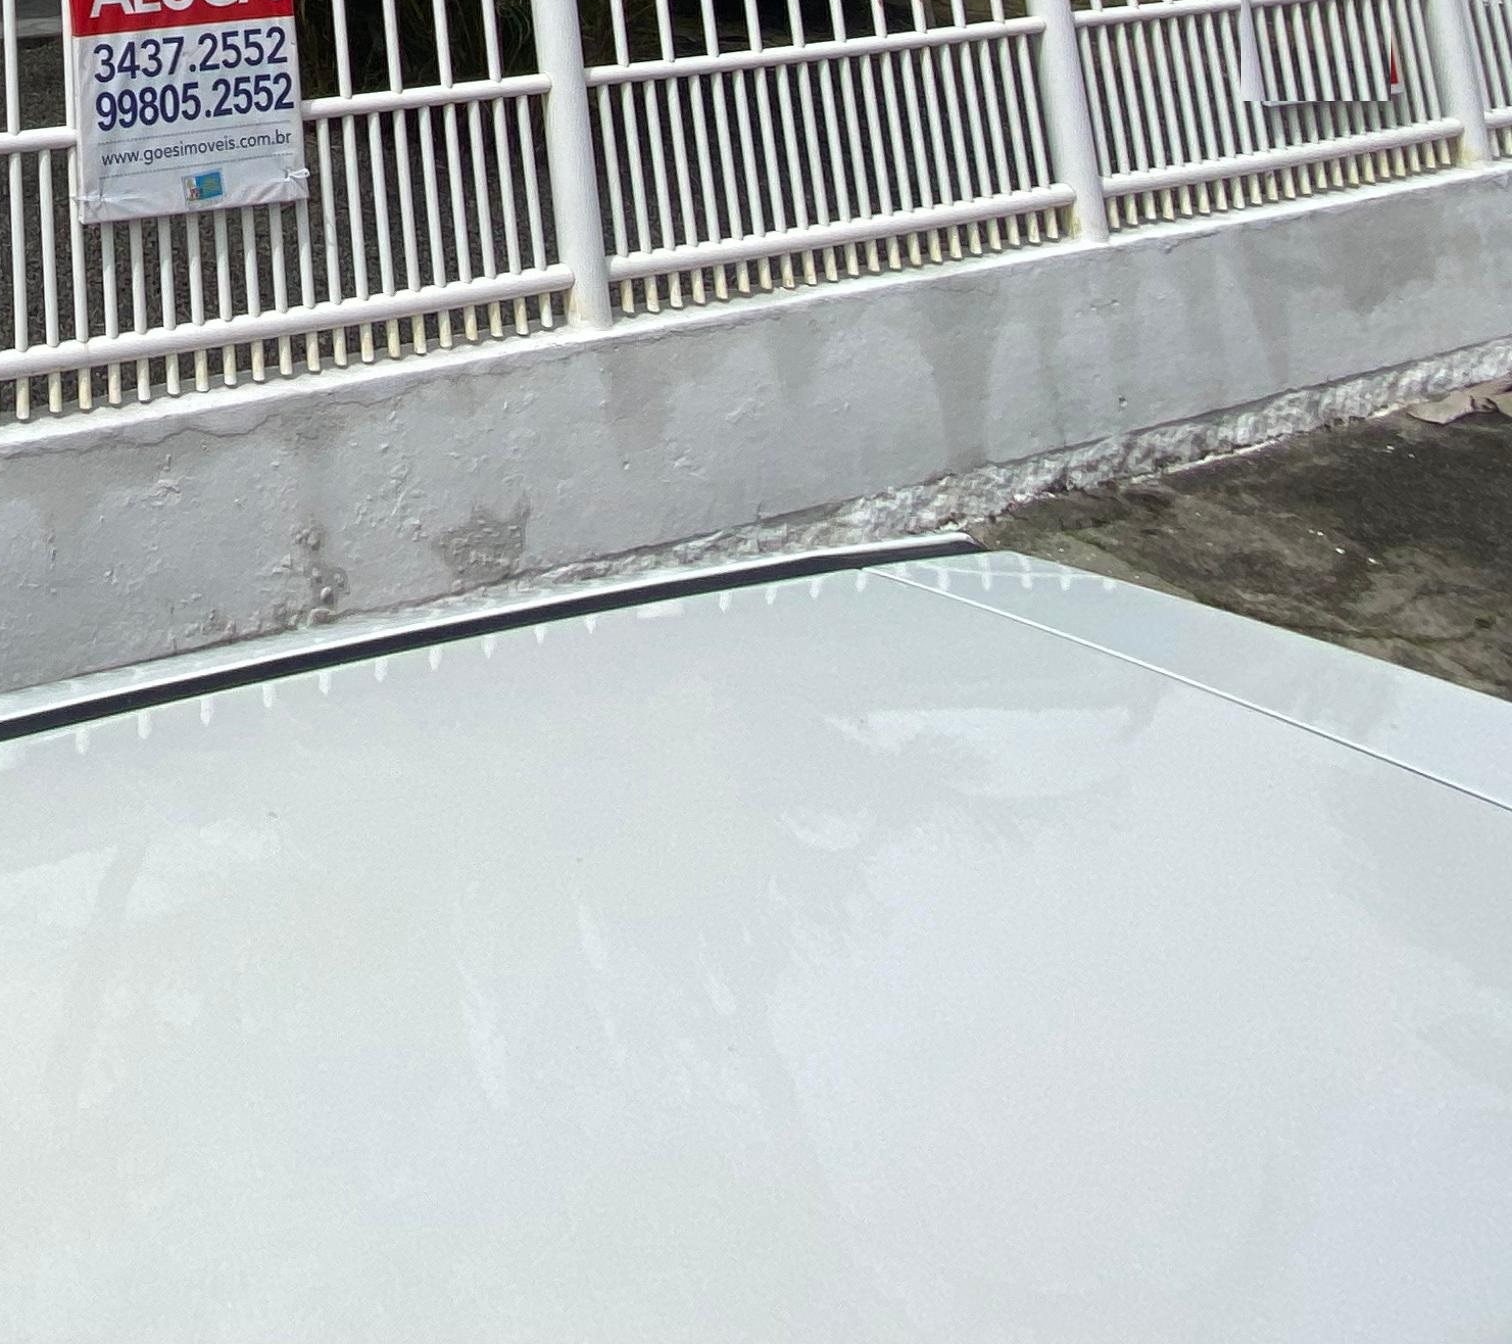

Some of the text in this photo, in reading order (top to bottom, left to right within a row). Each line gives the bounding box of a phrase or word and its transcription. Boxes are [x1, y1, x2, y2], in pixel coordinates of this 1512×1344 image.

[93, 26, 288, 83] 3437.2552
[95, 72, 294, 132] 99805.2552
[101, 129, 293, 168] www.goesimoveis.com.br
